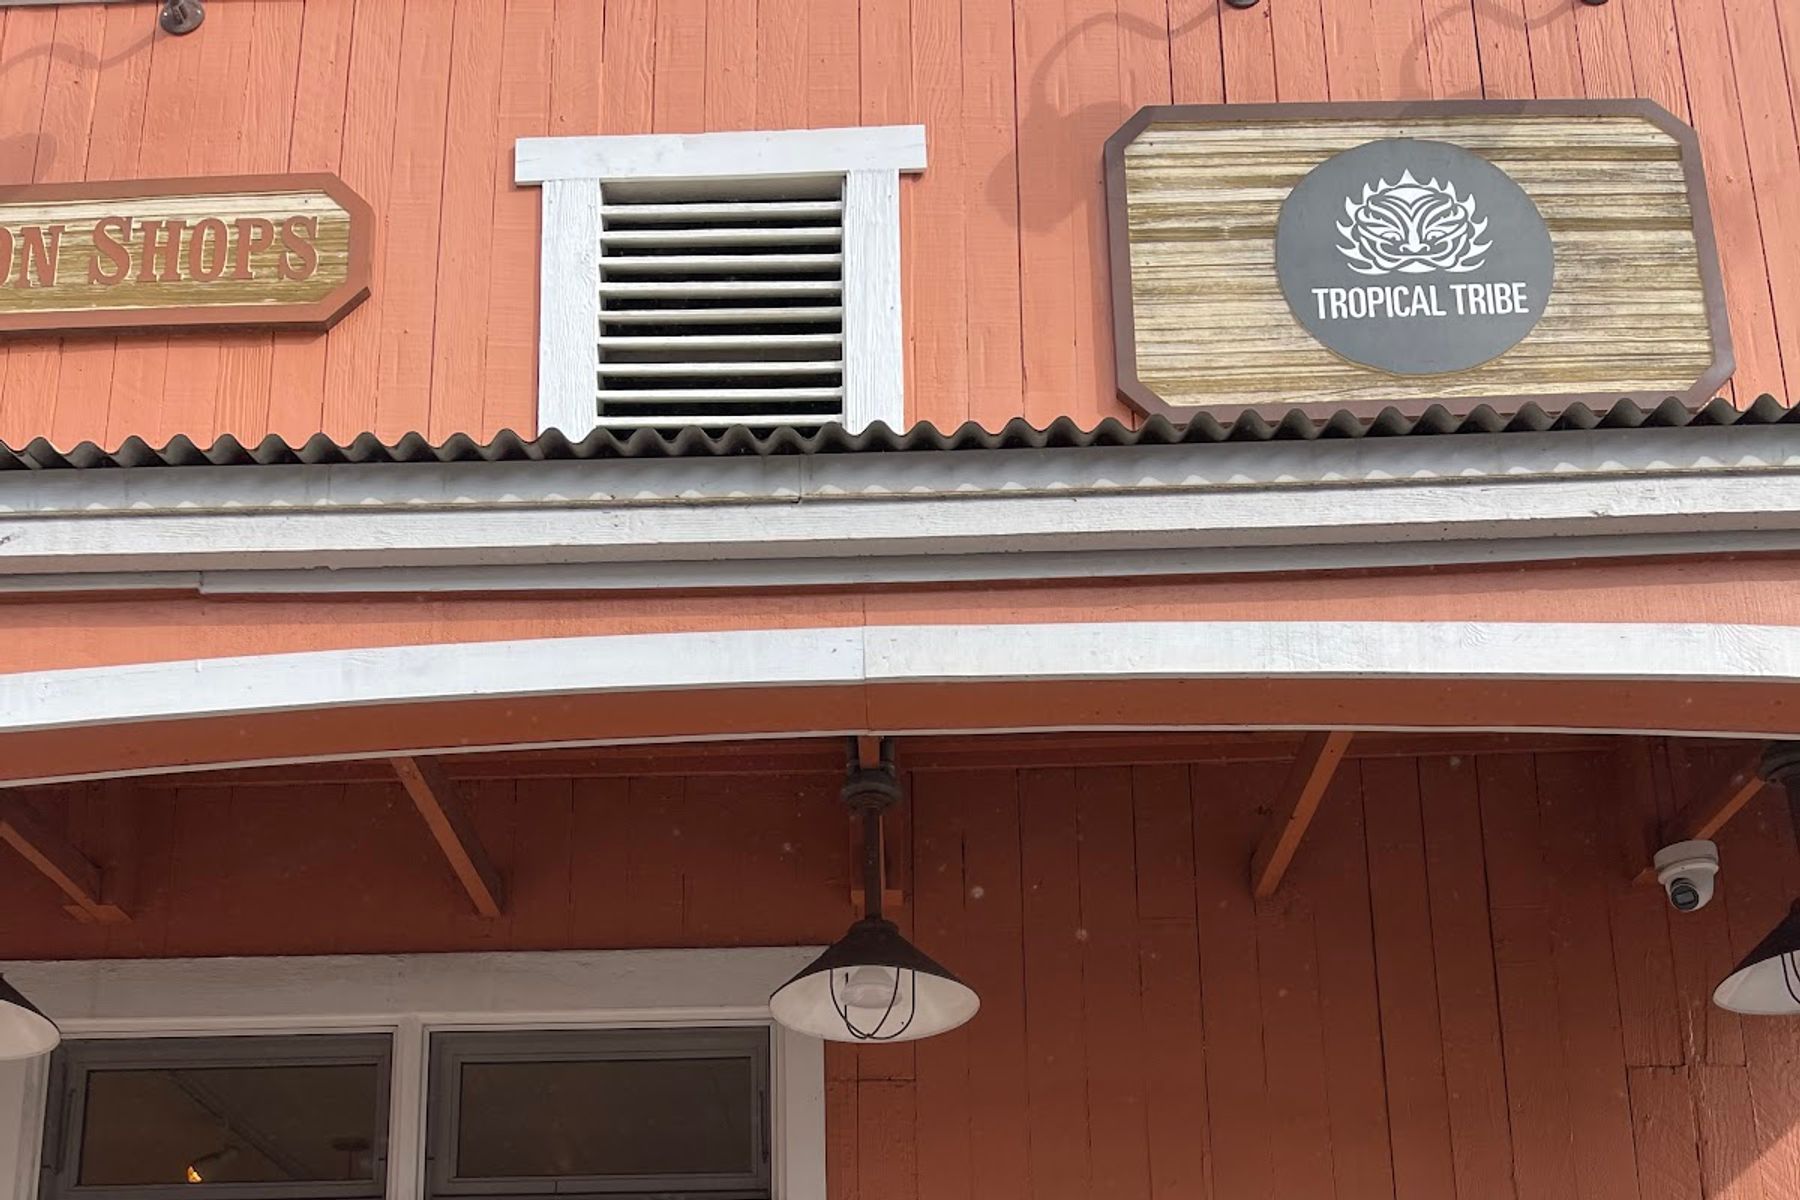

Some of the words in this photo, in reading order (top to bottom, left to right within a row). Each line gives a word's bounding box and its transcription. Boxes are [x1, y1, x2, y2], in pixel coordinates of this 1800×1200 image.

[88, 215, 321, 287] SHOPS
[1311, 285, 1448, 320] TROPICAL
[1449, 282, 1530, 316] TRIBE
